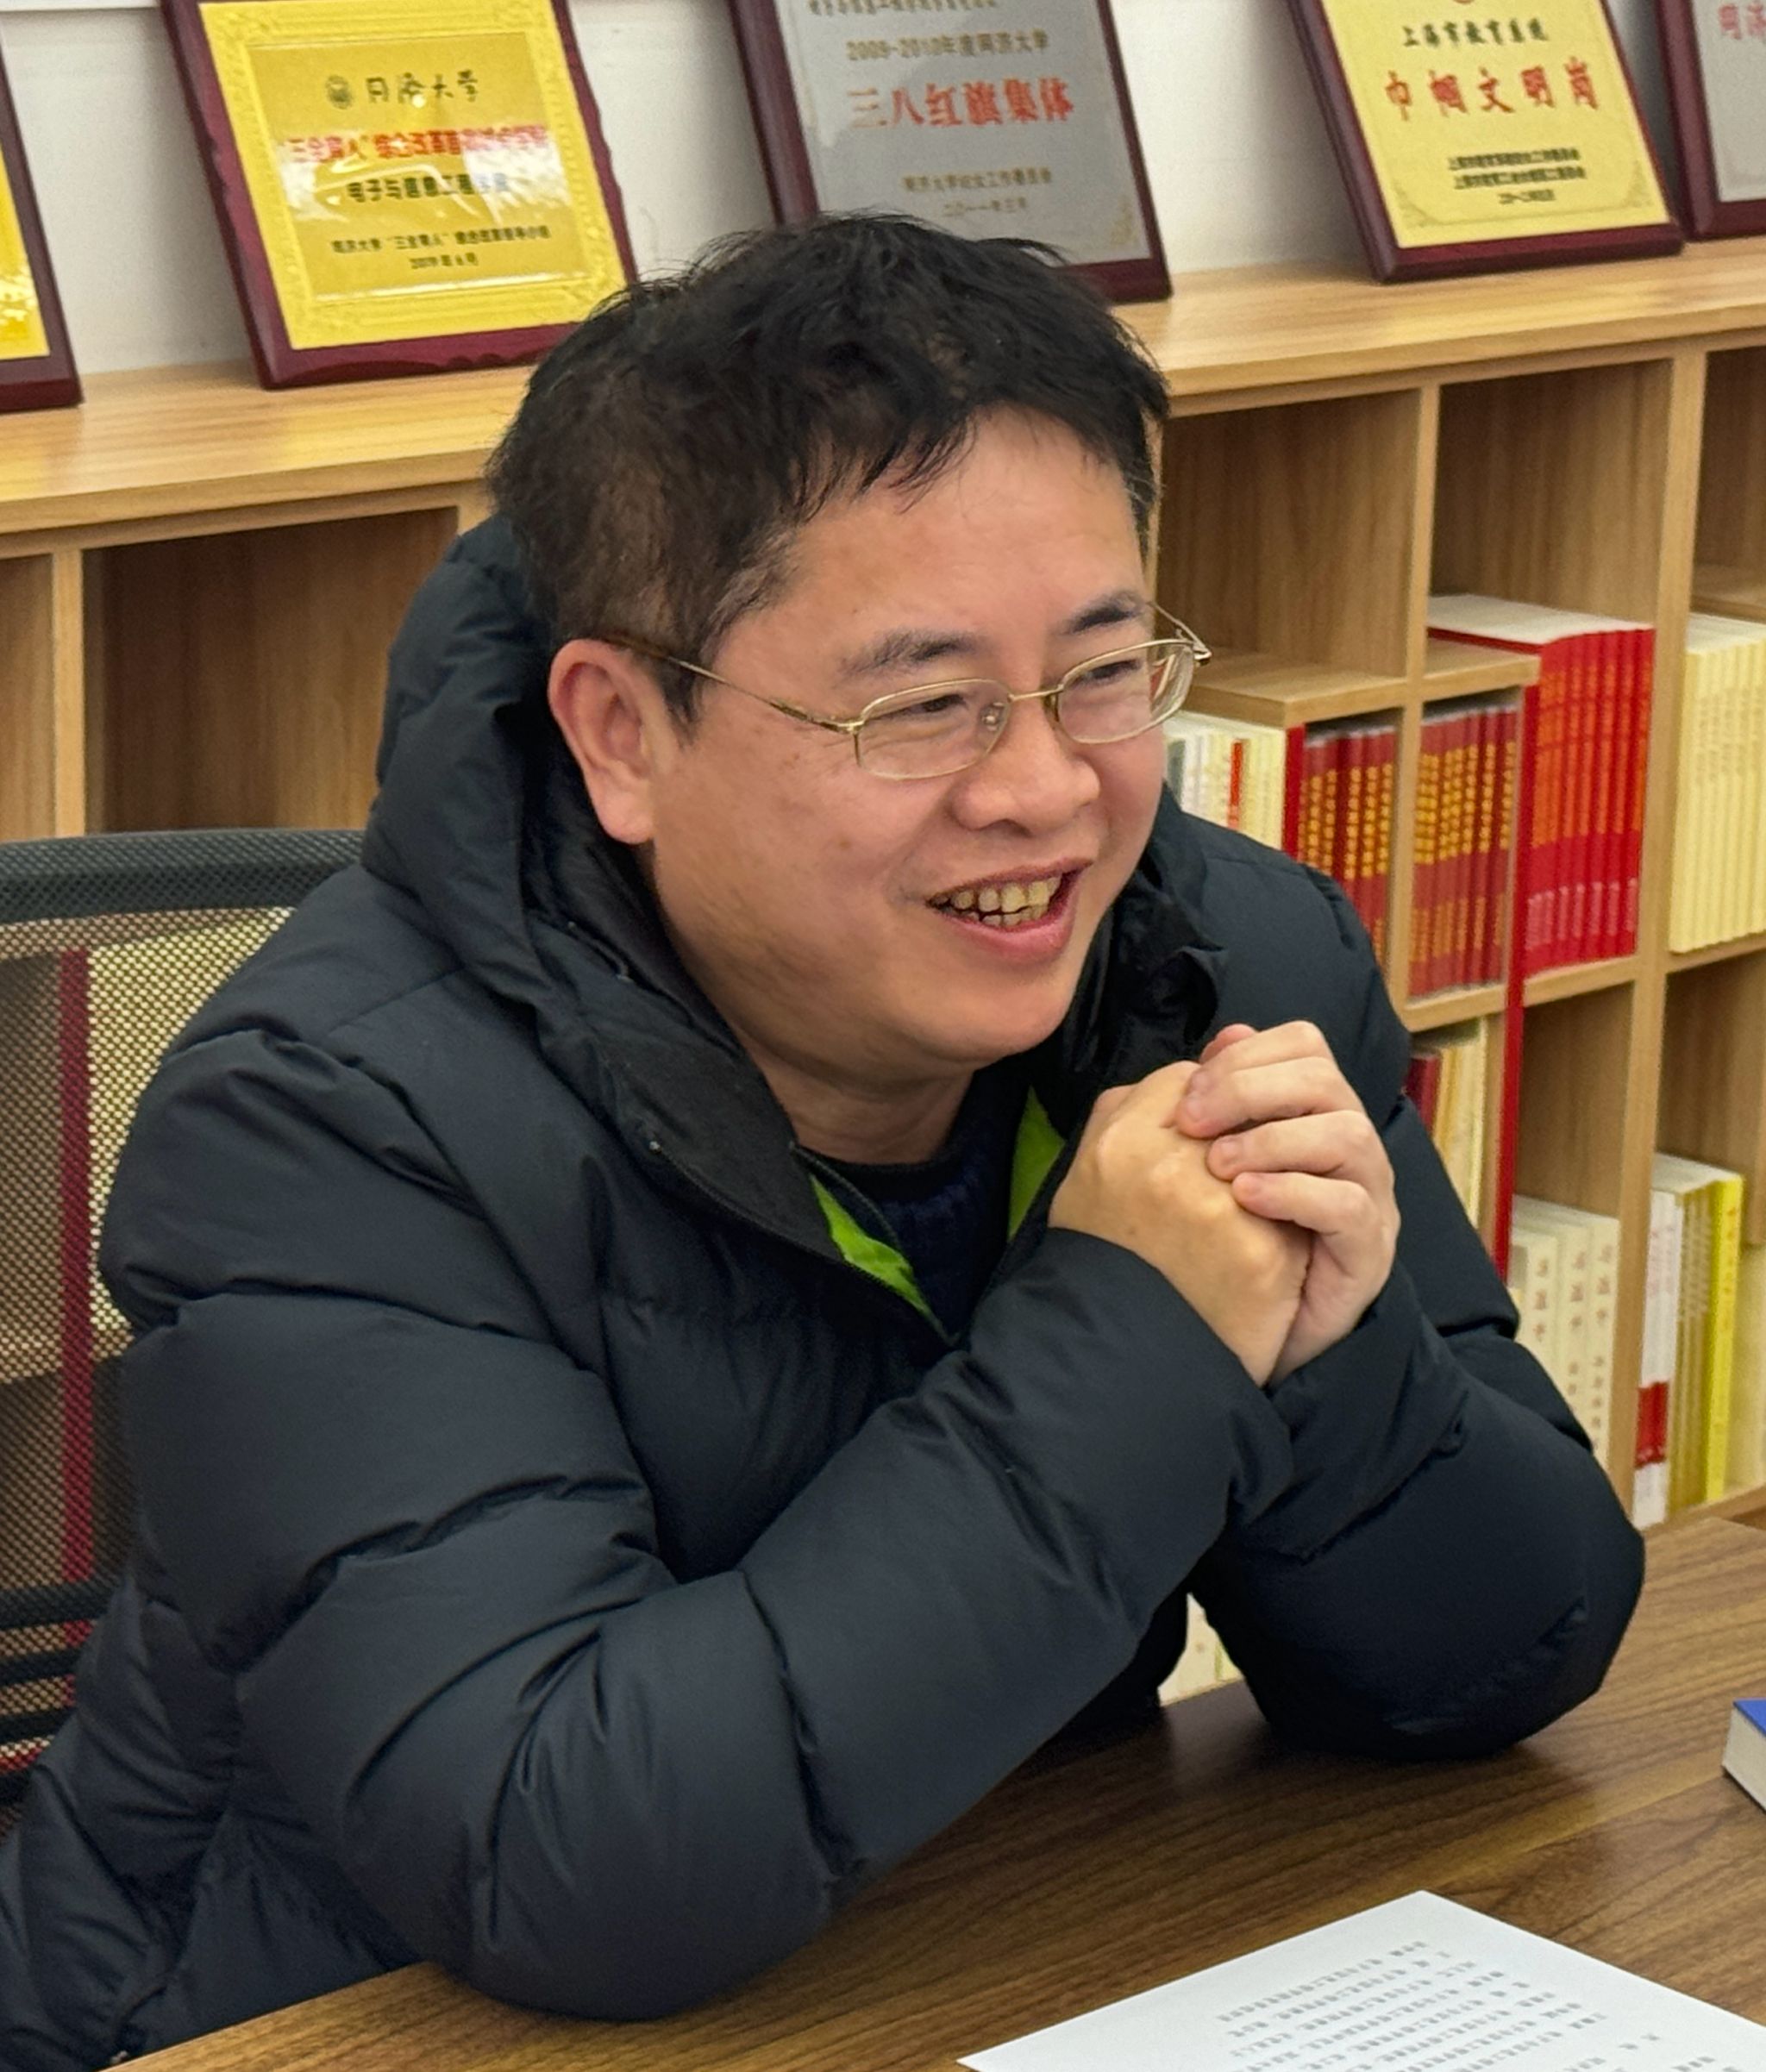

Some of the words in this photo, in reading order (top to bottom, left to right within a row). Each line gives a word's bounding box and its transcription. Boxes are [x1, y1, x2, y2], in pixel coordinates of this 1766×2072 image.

[366, 69, 479, 104] 同济大学
[849, 77, 1074, 128] 三八红旗集体
[1385, 56, 1598, 122] 巾帼文明岗
